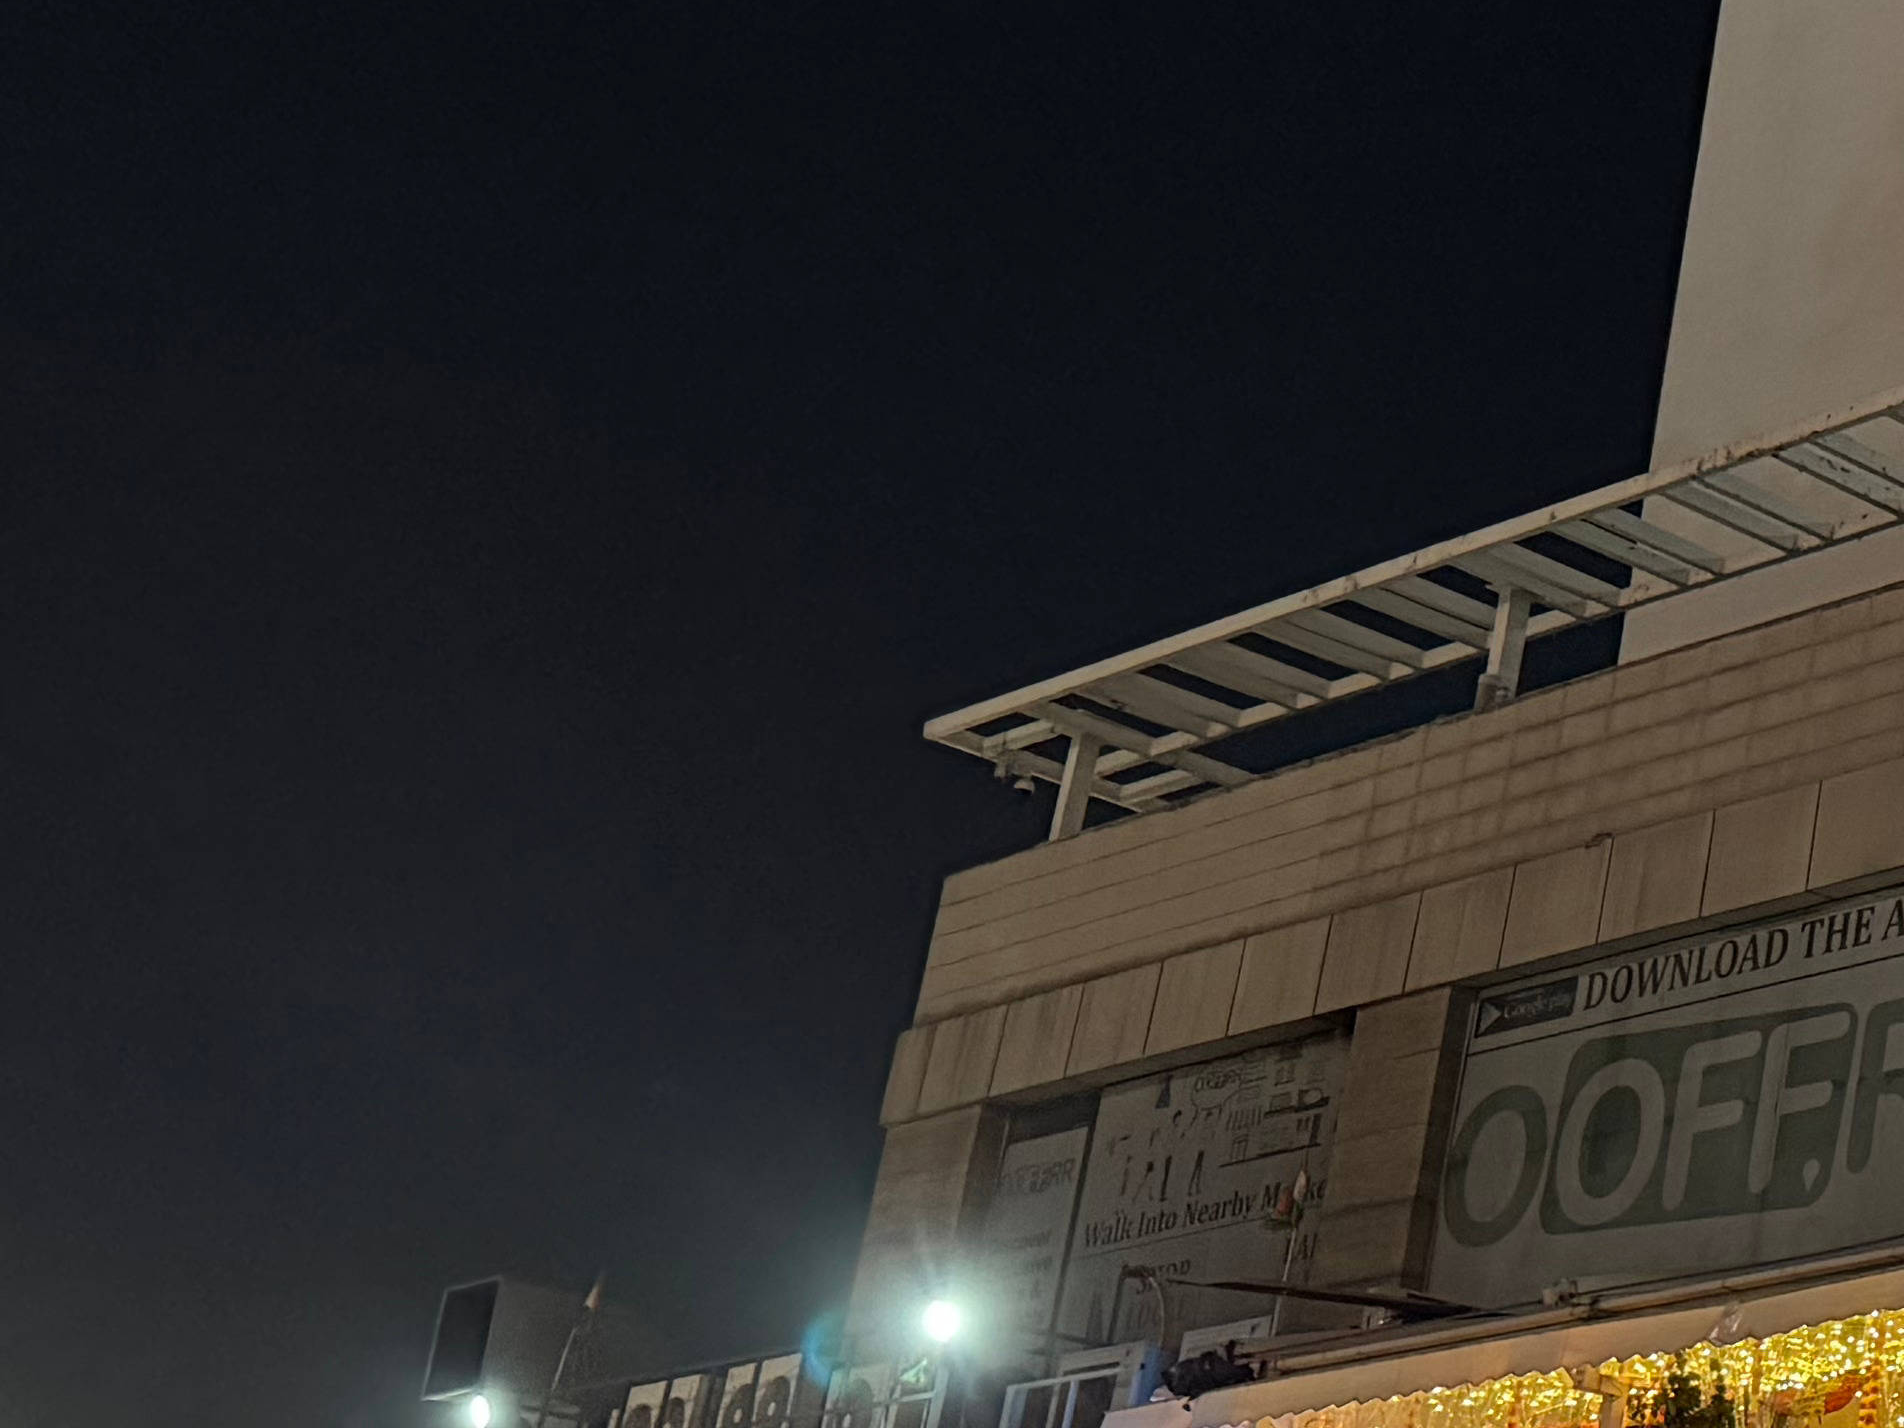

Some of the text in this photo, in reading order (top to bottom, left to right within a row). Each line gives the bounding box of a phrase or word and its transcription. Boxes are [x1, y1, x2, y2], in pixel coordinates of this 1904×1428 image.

[1584, 927, 1790, 1012] DOWNLOAD
[1800, 907, 1875, 960] THE
[1085, 1209, 1132, 1248] Walk
[1137, 1209, 1178, 1239] Into
[1182, 1190, 1258, 1228] Nearby
